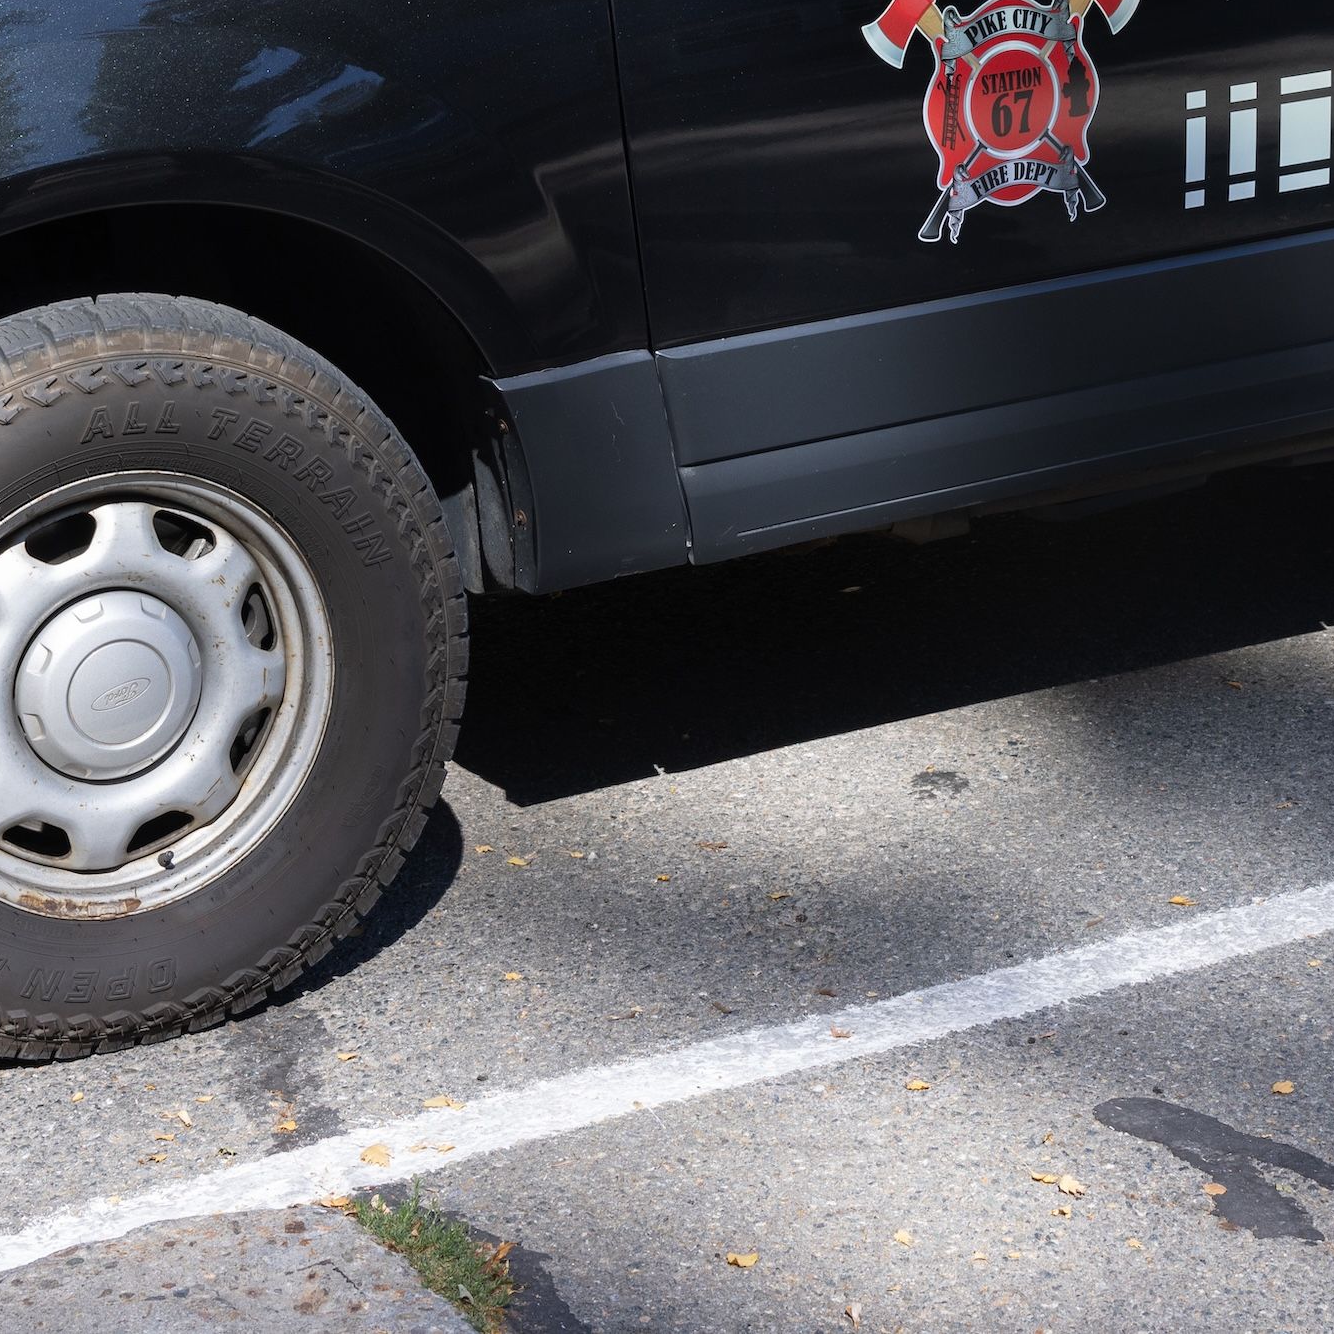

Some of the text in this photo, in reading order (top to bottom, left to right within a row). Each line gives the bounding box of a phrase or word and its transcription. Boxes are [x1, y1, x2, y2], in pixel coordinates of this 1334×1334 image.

[964, 9, 1053, 47] PIKE CITY
[982, 67, 1042, 95] STATION
[992, 90, 1033, 137] 67
[970, 162, 1058, 199] FIRE DEPT
[80, 400, 182, 444] ALL
[207, 406, 394, 570] TERRAIN
[20, 955, 179, 1004] OPEN
